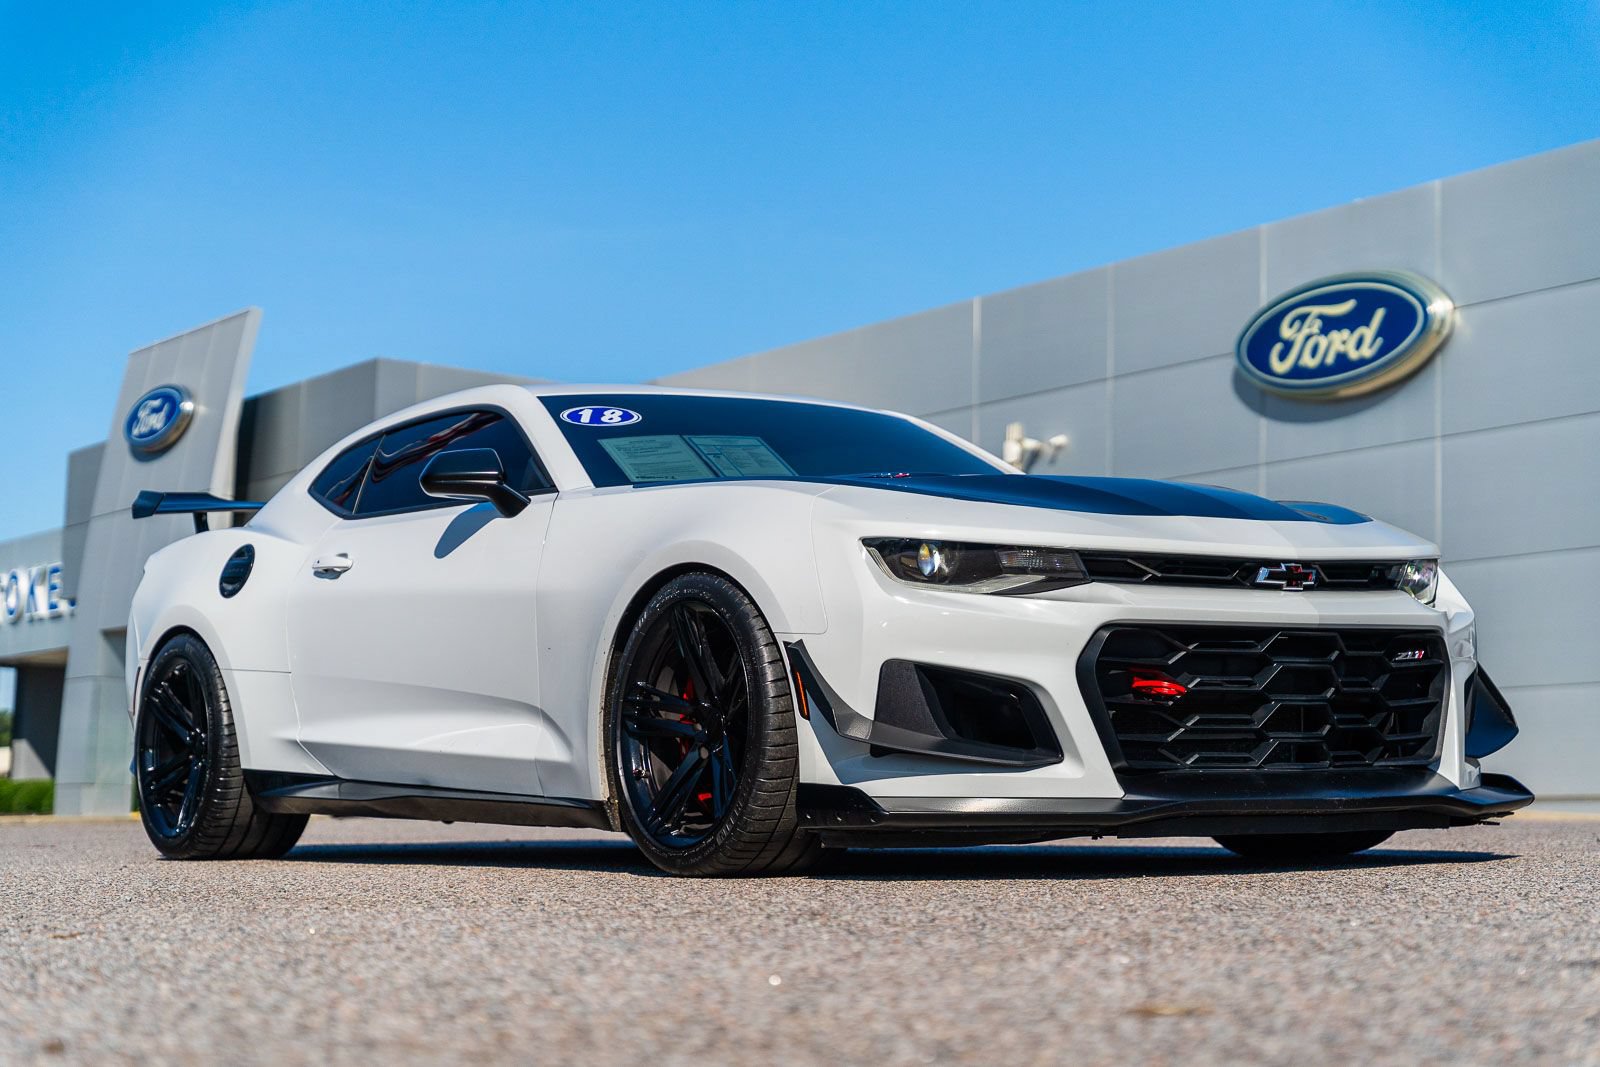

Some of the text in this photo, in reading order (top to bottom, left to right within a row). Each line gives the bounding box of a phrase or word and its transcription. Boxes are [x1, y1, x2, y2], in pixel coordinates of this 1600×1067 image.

[1270, 299, 1386, 374] Ford
[131, 397, 170, 437] Ford
[577, 407, 624, 424] 18
[0, 562, 77, 622] OKE
